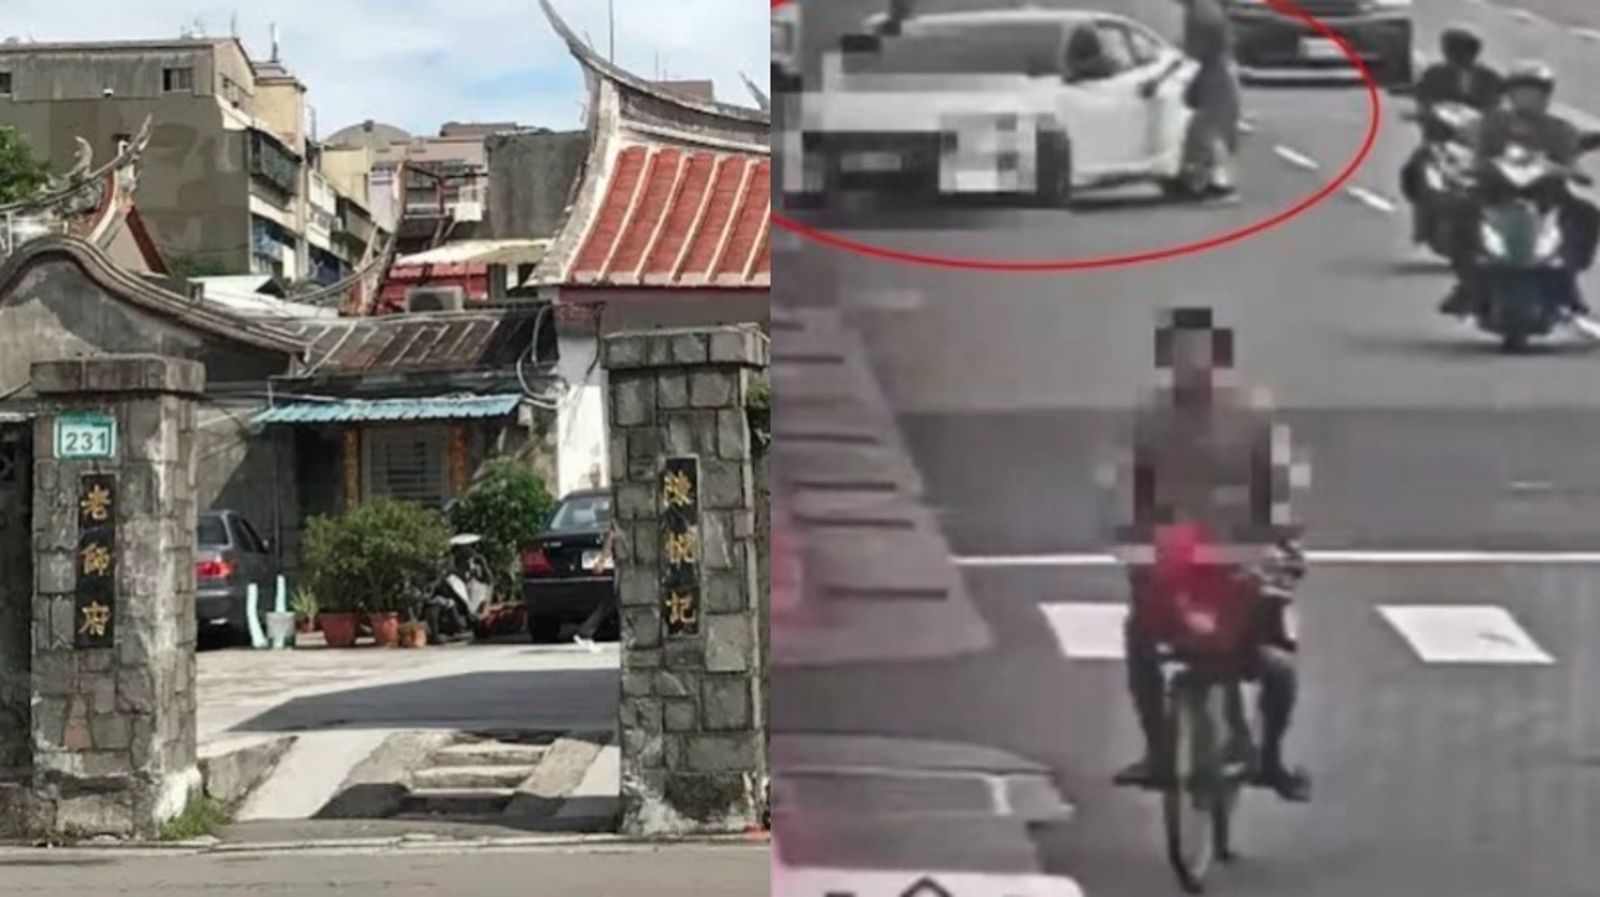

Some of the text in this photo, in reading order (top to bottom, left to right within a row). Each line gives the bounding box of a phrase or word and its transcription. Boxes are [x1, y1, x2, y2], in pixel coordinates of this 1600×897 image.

[65, 431, 106, 451] 231
[78, 484, 111, 636] 老師府
